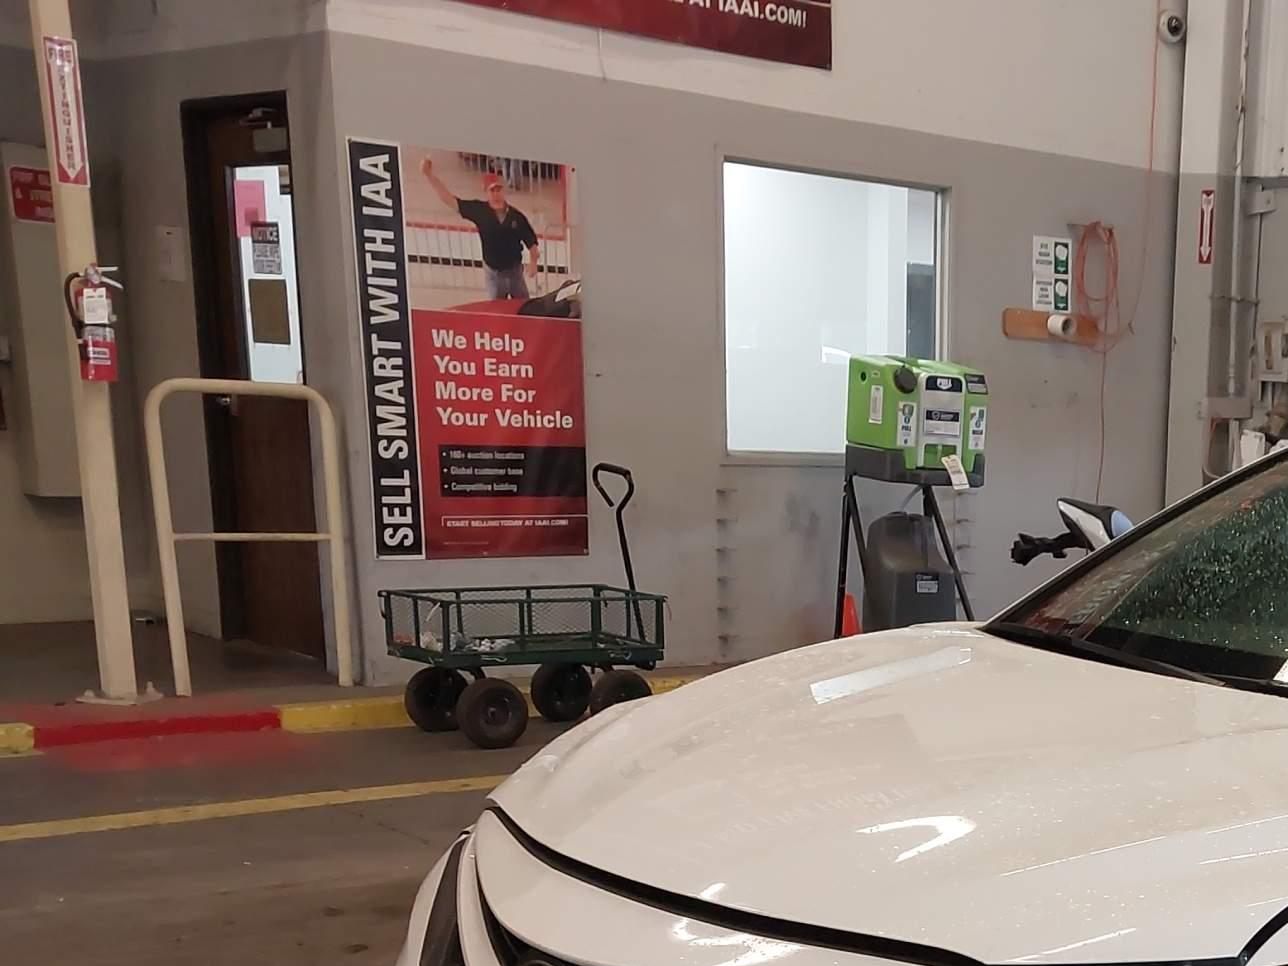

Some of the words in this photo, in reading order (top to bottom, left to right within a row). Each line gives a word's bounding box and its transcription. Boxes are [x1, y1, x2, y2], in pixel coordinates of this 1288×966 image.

[359, 153, 394, 217] IAA
[363, 228, 401, 325] WITH
[431, 329, 467, 349] We
[474, 331, 525, 356] Help
[433, 355, 476, 375] You
[484, 357, 534, 378] Earn
[371, 333, 409, 459] SMART
[434, 381, 494, 402] More
[500, 383, 537, 403] For
[435, 406, 489, 427] Your
[494, 408, 574, 429] Vehicle
[381, 469, 414, 546] SELL
